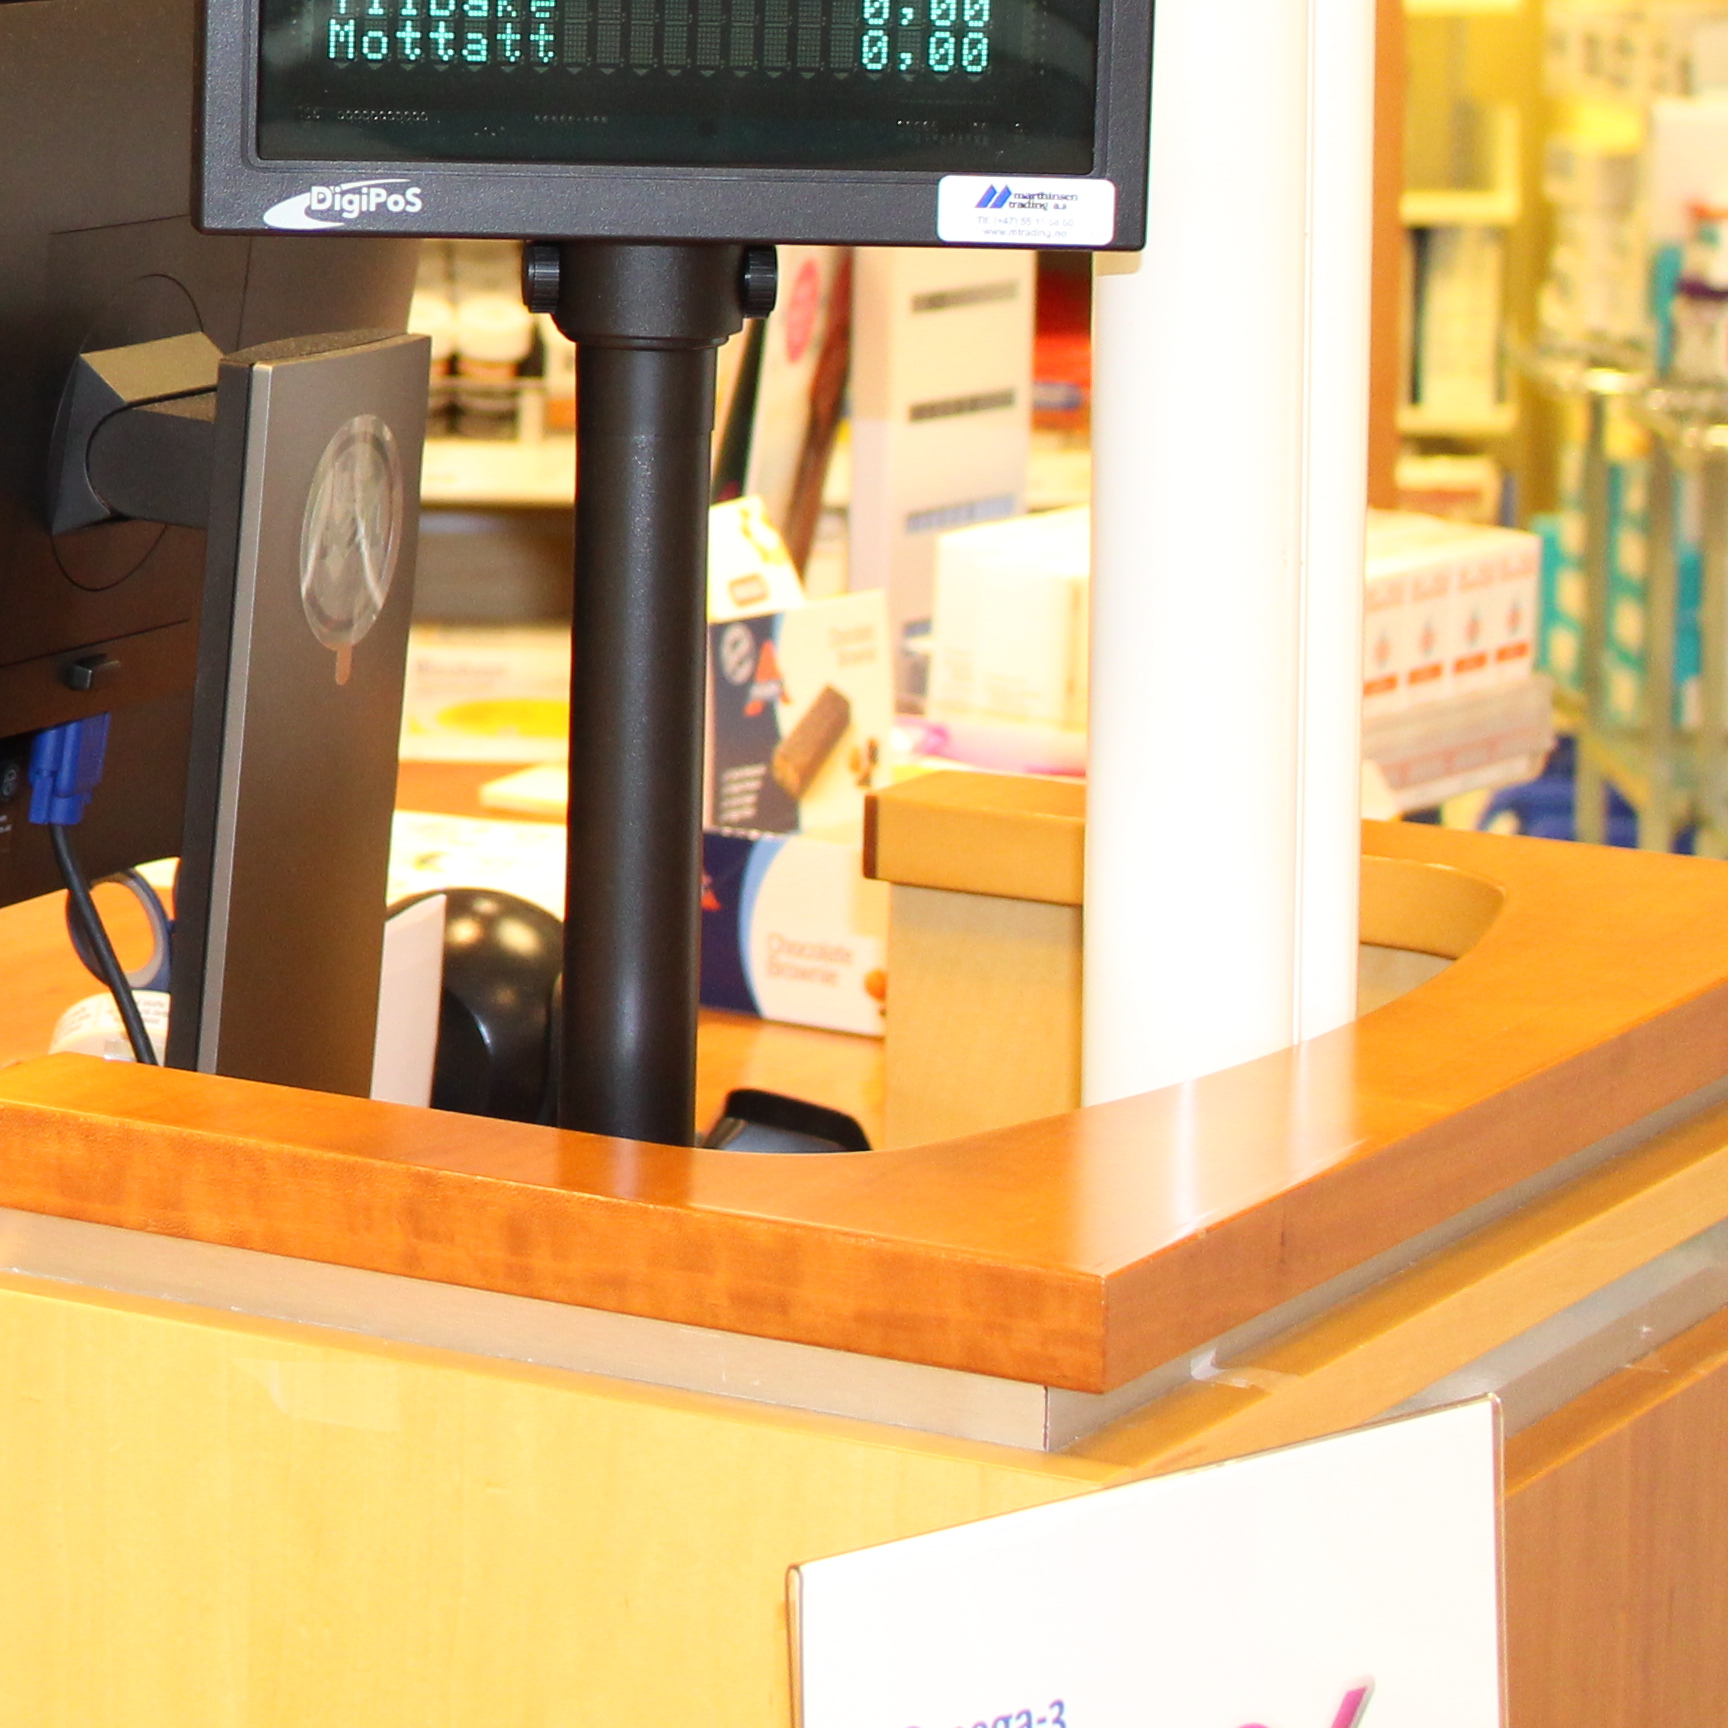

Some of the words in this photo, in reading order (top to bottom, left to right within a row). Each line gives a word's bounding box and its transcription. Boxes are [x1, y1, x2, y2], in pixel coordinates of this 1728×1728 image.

[327, 19, 558, 65] Mottatt
[860, 32, 991, 74] 0,00
[310, 185, 423, 219] DigiPoS
